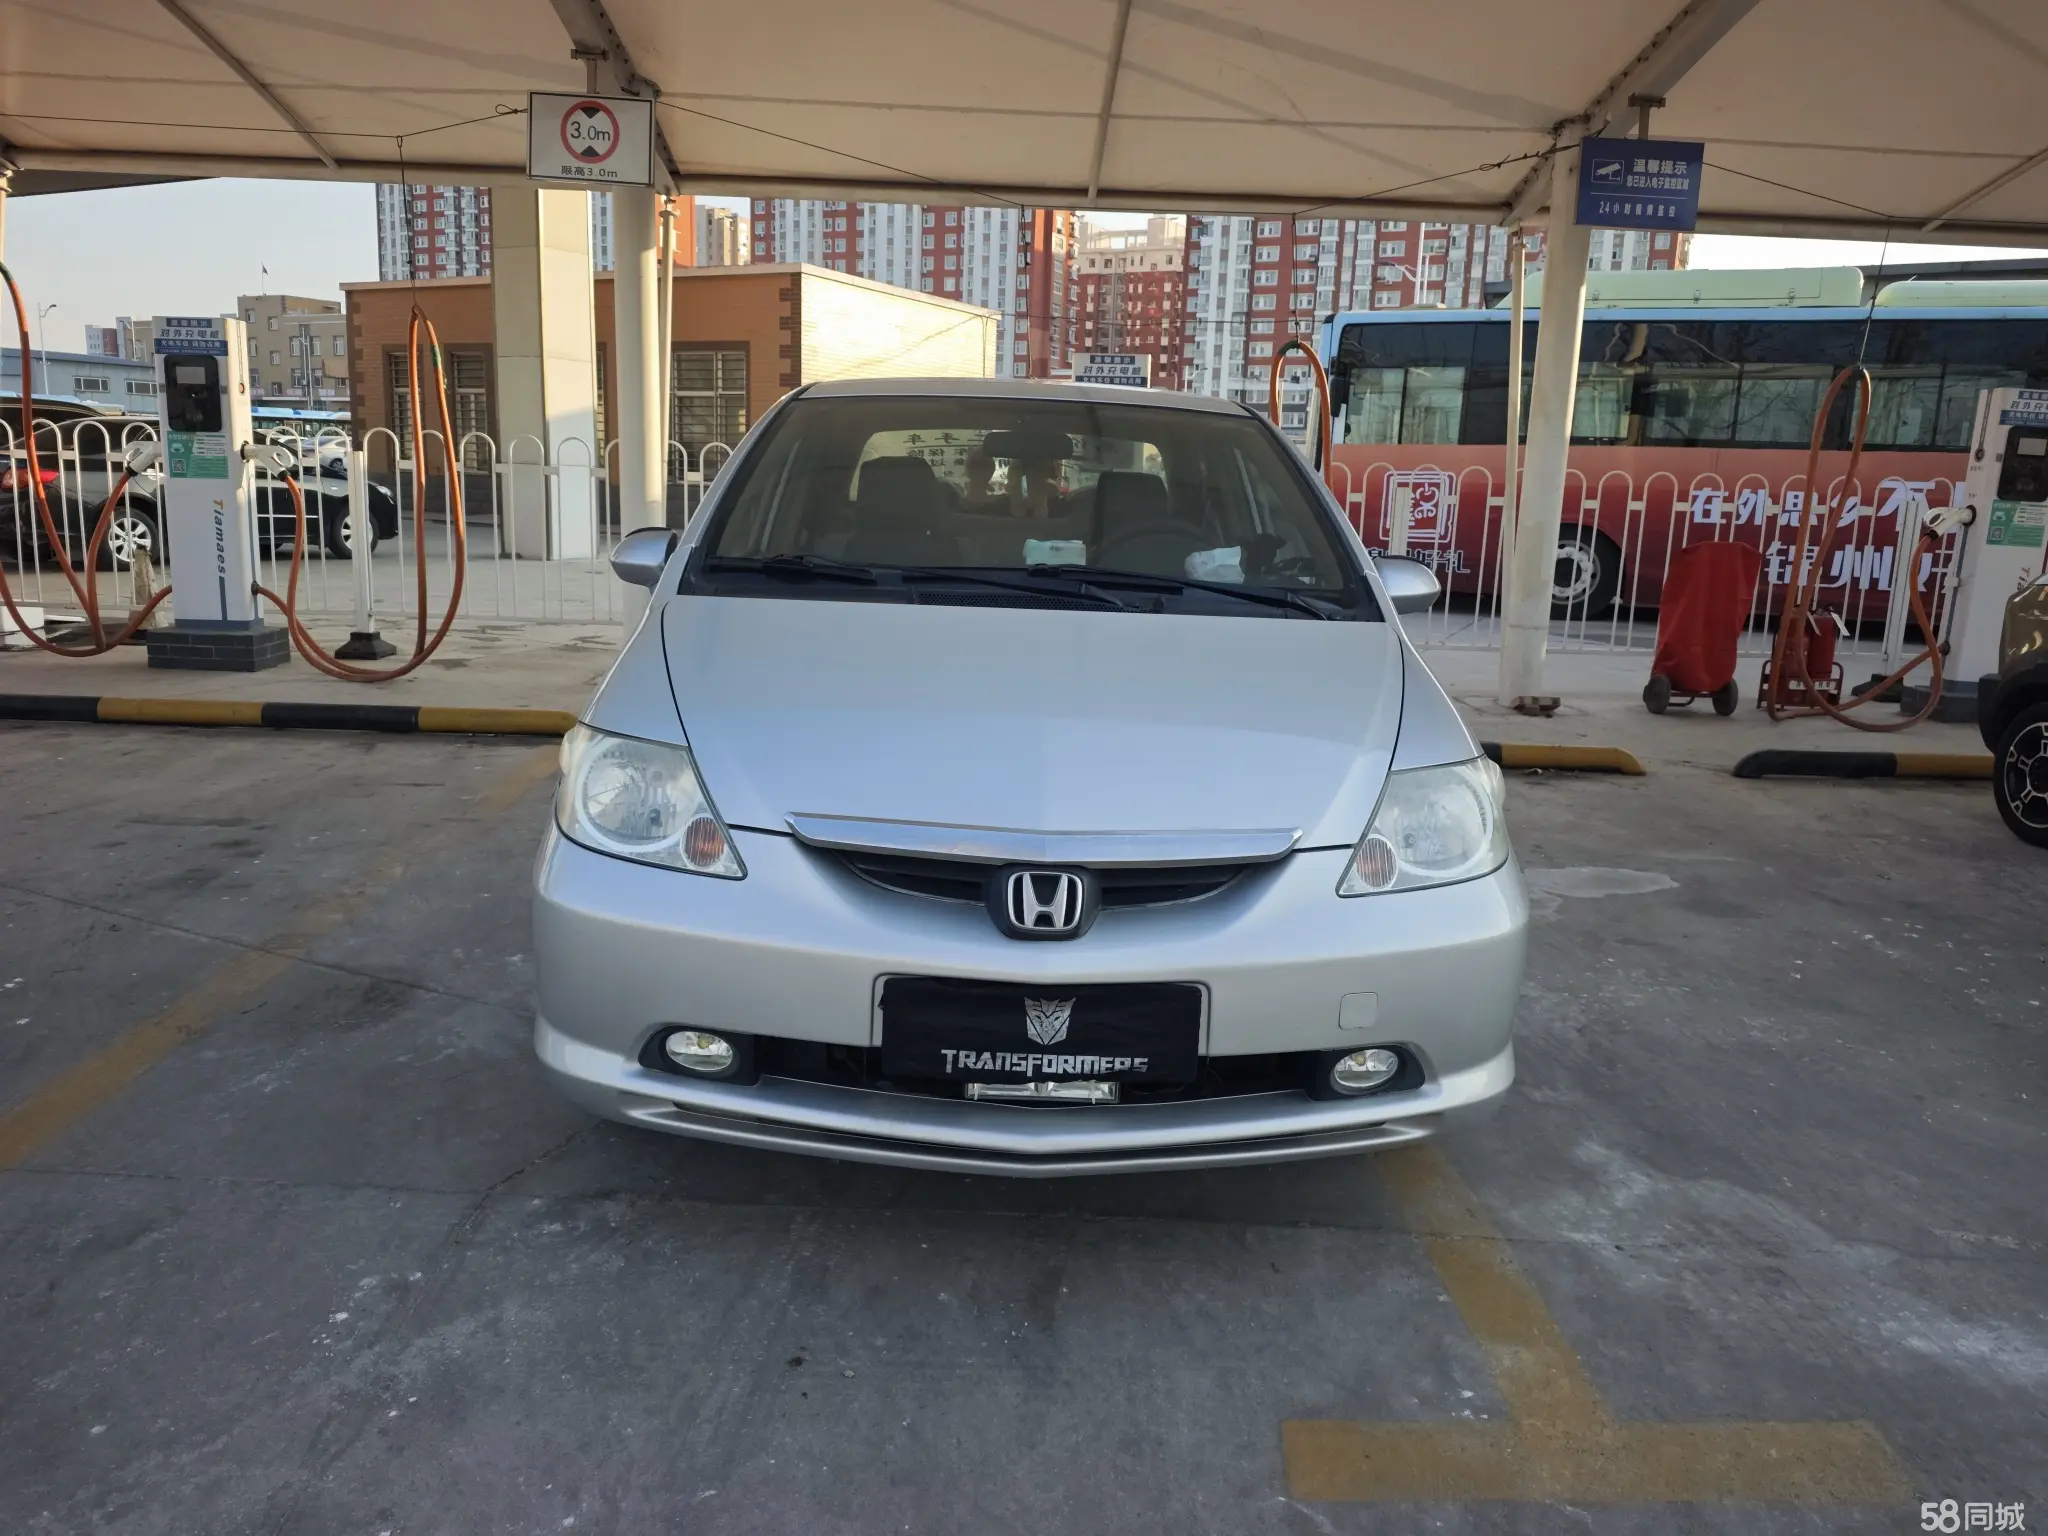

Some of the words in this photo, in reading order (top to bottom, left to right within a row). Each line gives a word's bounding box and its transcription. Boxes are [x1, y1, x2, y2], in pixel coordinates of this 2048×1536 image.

[570, 121, 611, 142] 3.0m
[561, 165, 618, 178] 限高3.0m
[1633, 158, 1688, 175] 温馨提示
[941, 1049, 1149, 1077] TRANSFORMERS
